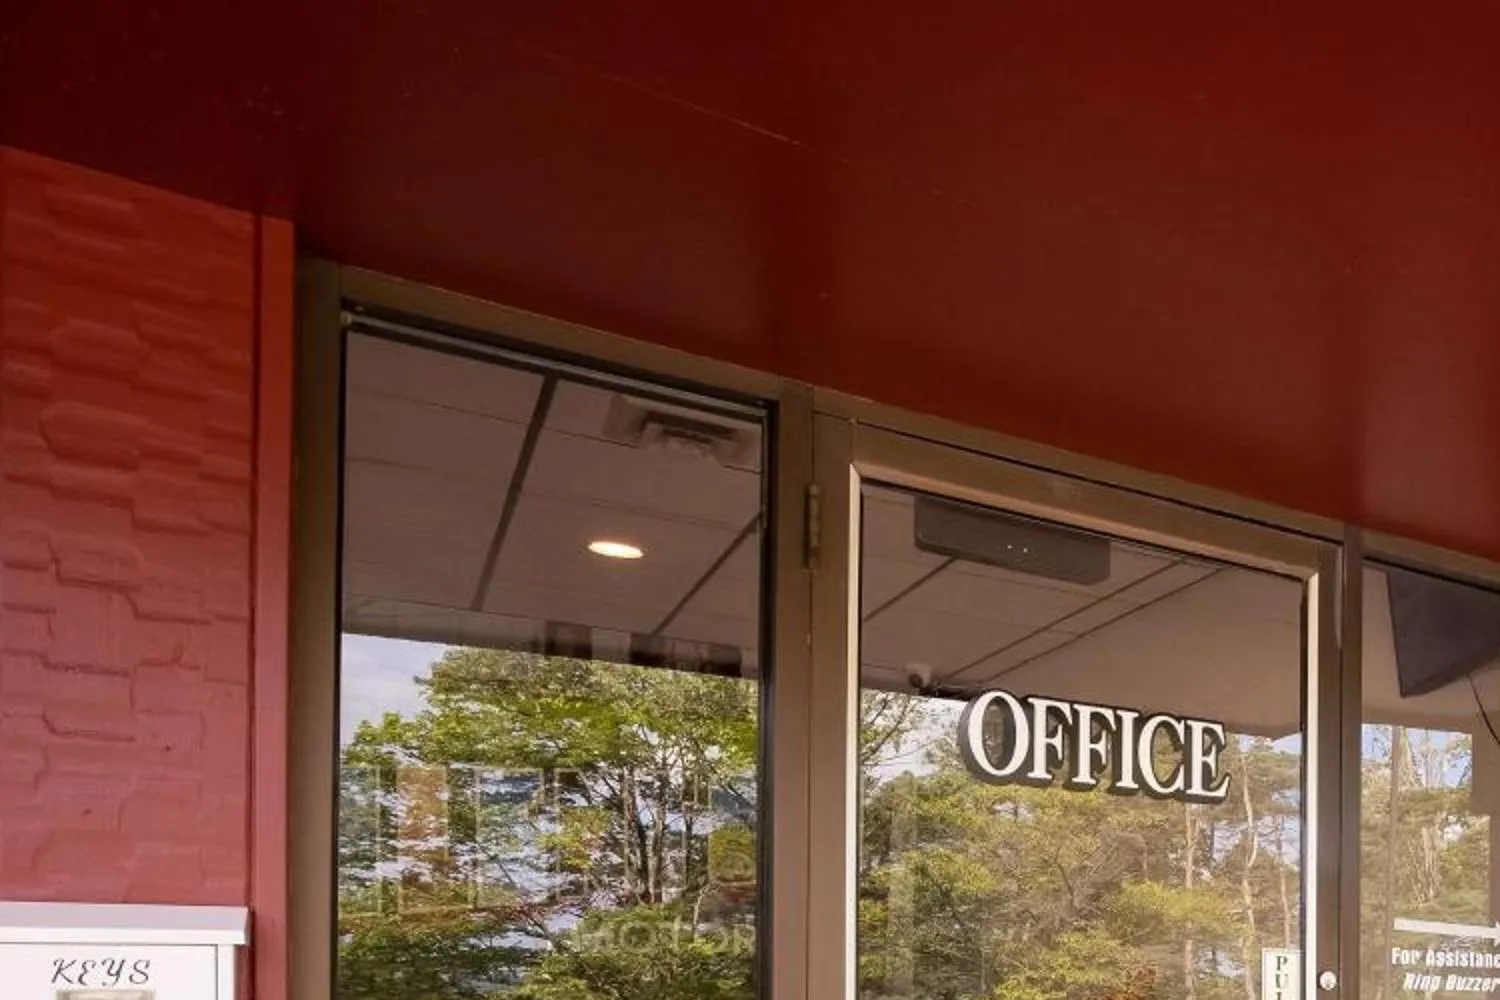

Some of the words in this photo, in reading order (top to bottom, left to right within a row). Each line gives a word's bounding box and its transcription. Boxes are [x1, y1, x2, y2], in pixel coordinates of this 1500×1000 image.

[960, 688, 1232, 802] OFFICE
[1391, 946, 1422, 966] For
[51, 957, 151, 987] KEYS
[1402, 971, 1443, 993] Ring
[1445, 973, 1500, 993] Buzzer
